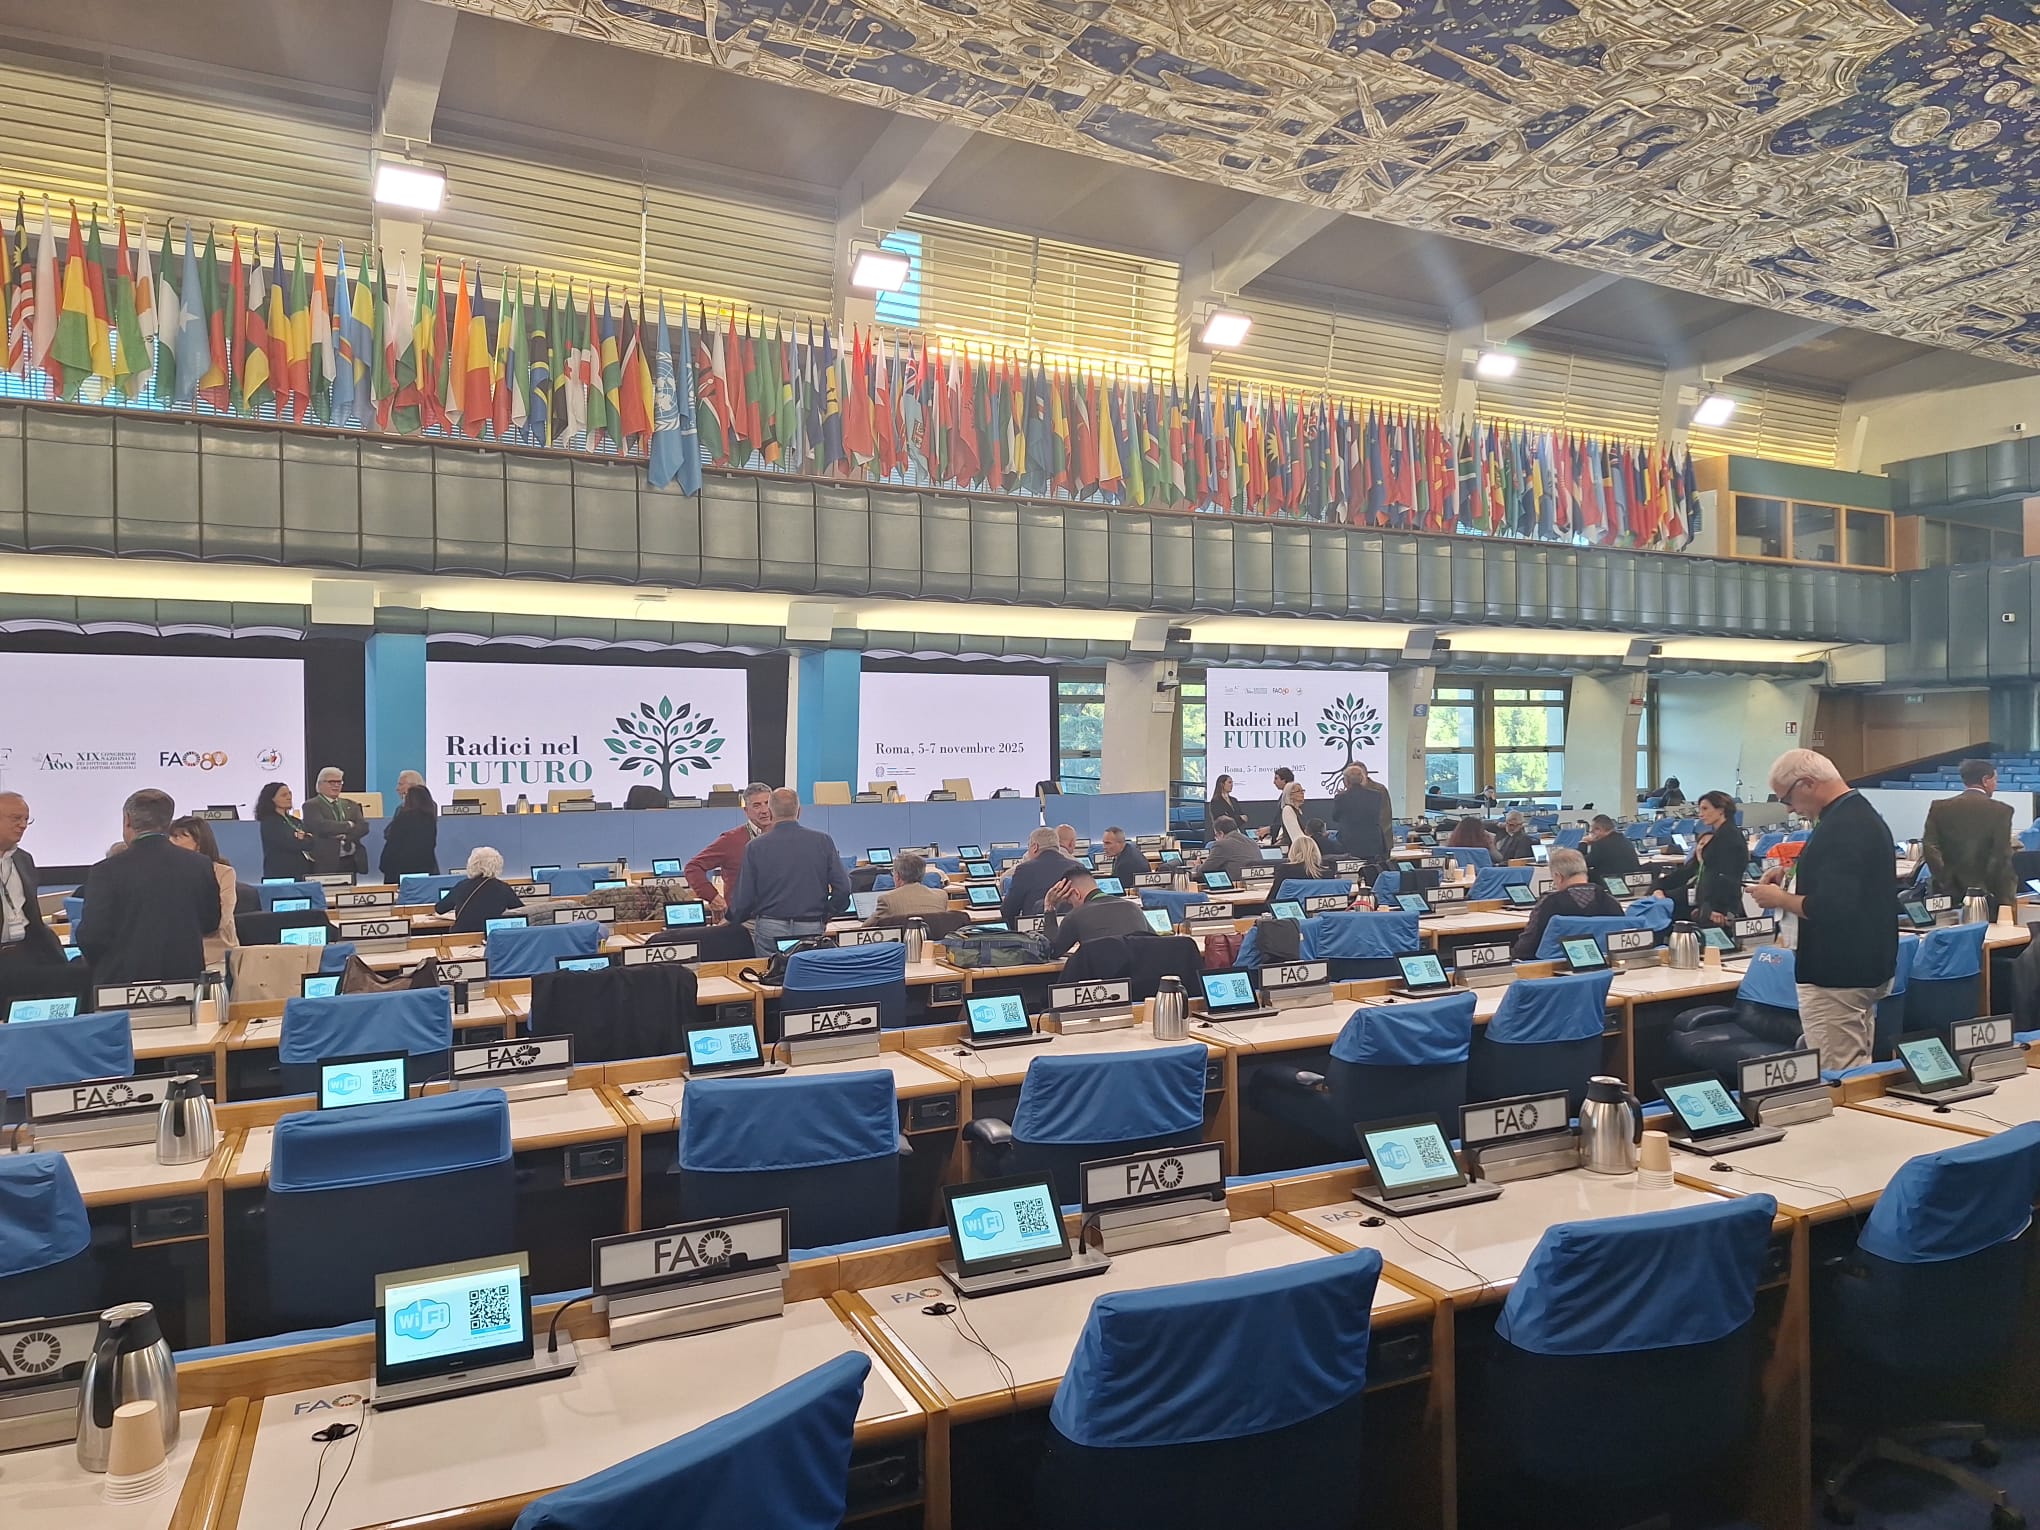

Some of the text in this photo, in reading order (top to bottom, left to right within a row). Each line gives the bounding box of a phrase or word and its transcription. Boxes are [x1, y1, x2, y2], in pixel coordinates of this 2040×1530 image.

[1224, 711, 1298, 727] Radici nel
[445, 735, 579, 756] Radici nel
[1224, 730, 1306, 748] FUTURO
[76, 752, 101, 761] XIX
[876, 742, 1025, 756] Roma, 5-7 novembre 2025
[445, 760, 593, 785] FUTURO
[1145, 874, 1161, 883] FAO
[353, 894, 377, 904] FAO
[1317, 897, 1336, 908] FAO
[1437, 890, 1453, 900] FAO
[571, 910, 598, 922] FAO
[360, 923, 389, 936] FAO
[1033, 919, 1045, 931] FA
[1746, 920, 1763, 933] FAO
[857, 930, 884, 944] FAO
[1621, 934, 1640, 947] FAO
[644, 946, 677, 962] FAO
[1471, 948, 1495, 964] FAO
[1280, 965, 1309, 984] FAO
[126, 985, 168, 1004] FAO
[1074, 985, 1107, 1005] FAO
[811, 1010, 852, 1032] FAO
[1970, 1022, 1996, 1046] FAO
[487, 1044, 537, 1069] FAO
[1765, 1059, 1797, 1087] FAO
[73, 1083, 134, 1110] FAO
[1495, 1103, 1538, 1135] FAO
[1126, 1158, 1184, 1195] FAO
[654, 1229, 733, 1274] FAO
[891, 1287, 943, 1303] FAO
[294, 1393, 362, 1415] FAO
